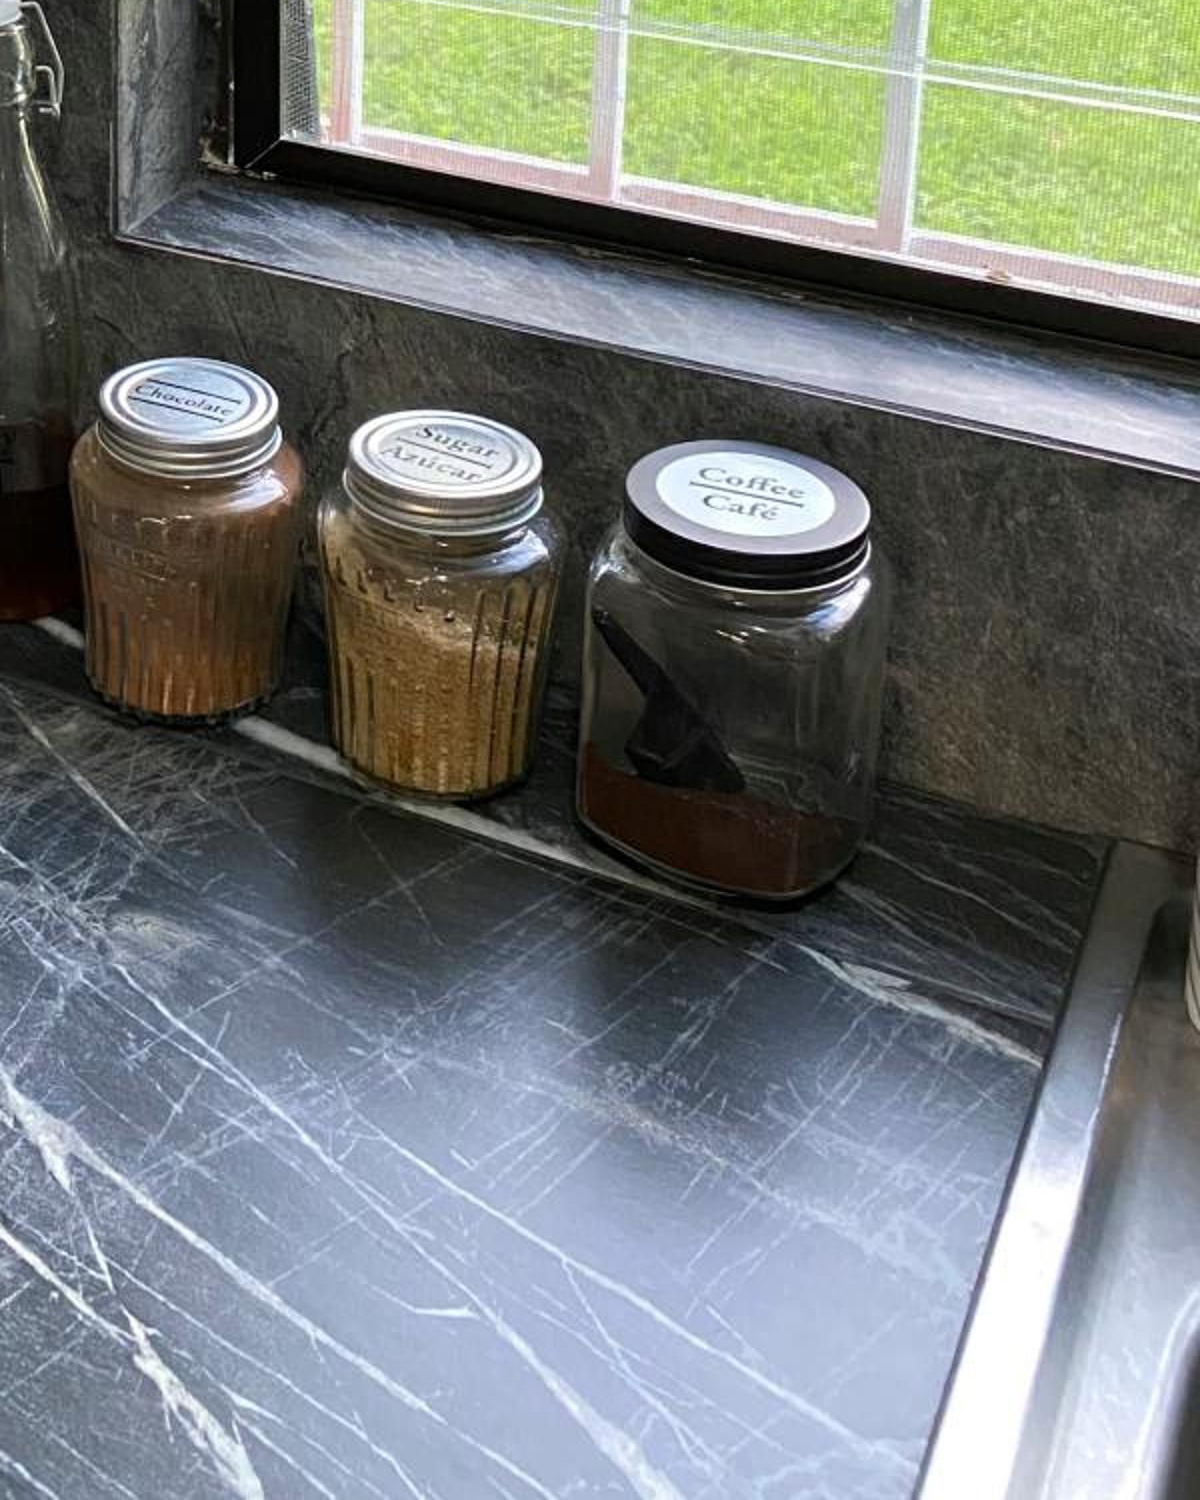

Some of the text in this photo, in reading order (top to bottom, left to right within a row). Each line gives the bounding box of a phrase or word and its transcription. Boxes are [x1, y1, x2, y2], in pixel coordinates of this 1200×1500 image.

[135, 385, 235, 416] Chocolate
[415, 426, 499, 457] Sugar
[698, 467, 806, 499] Coffee
[703, 495, 779, 521] Café
